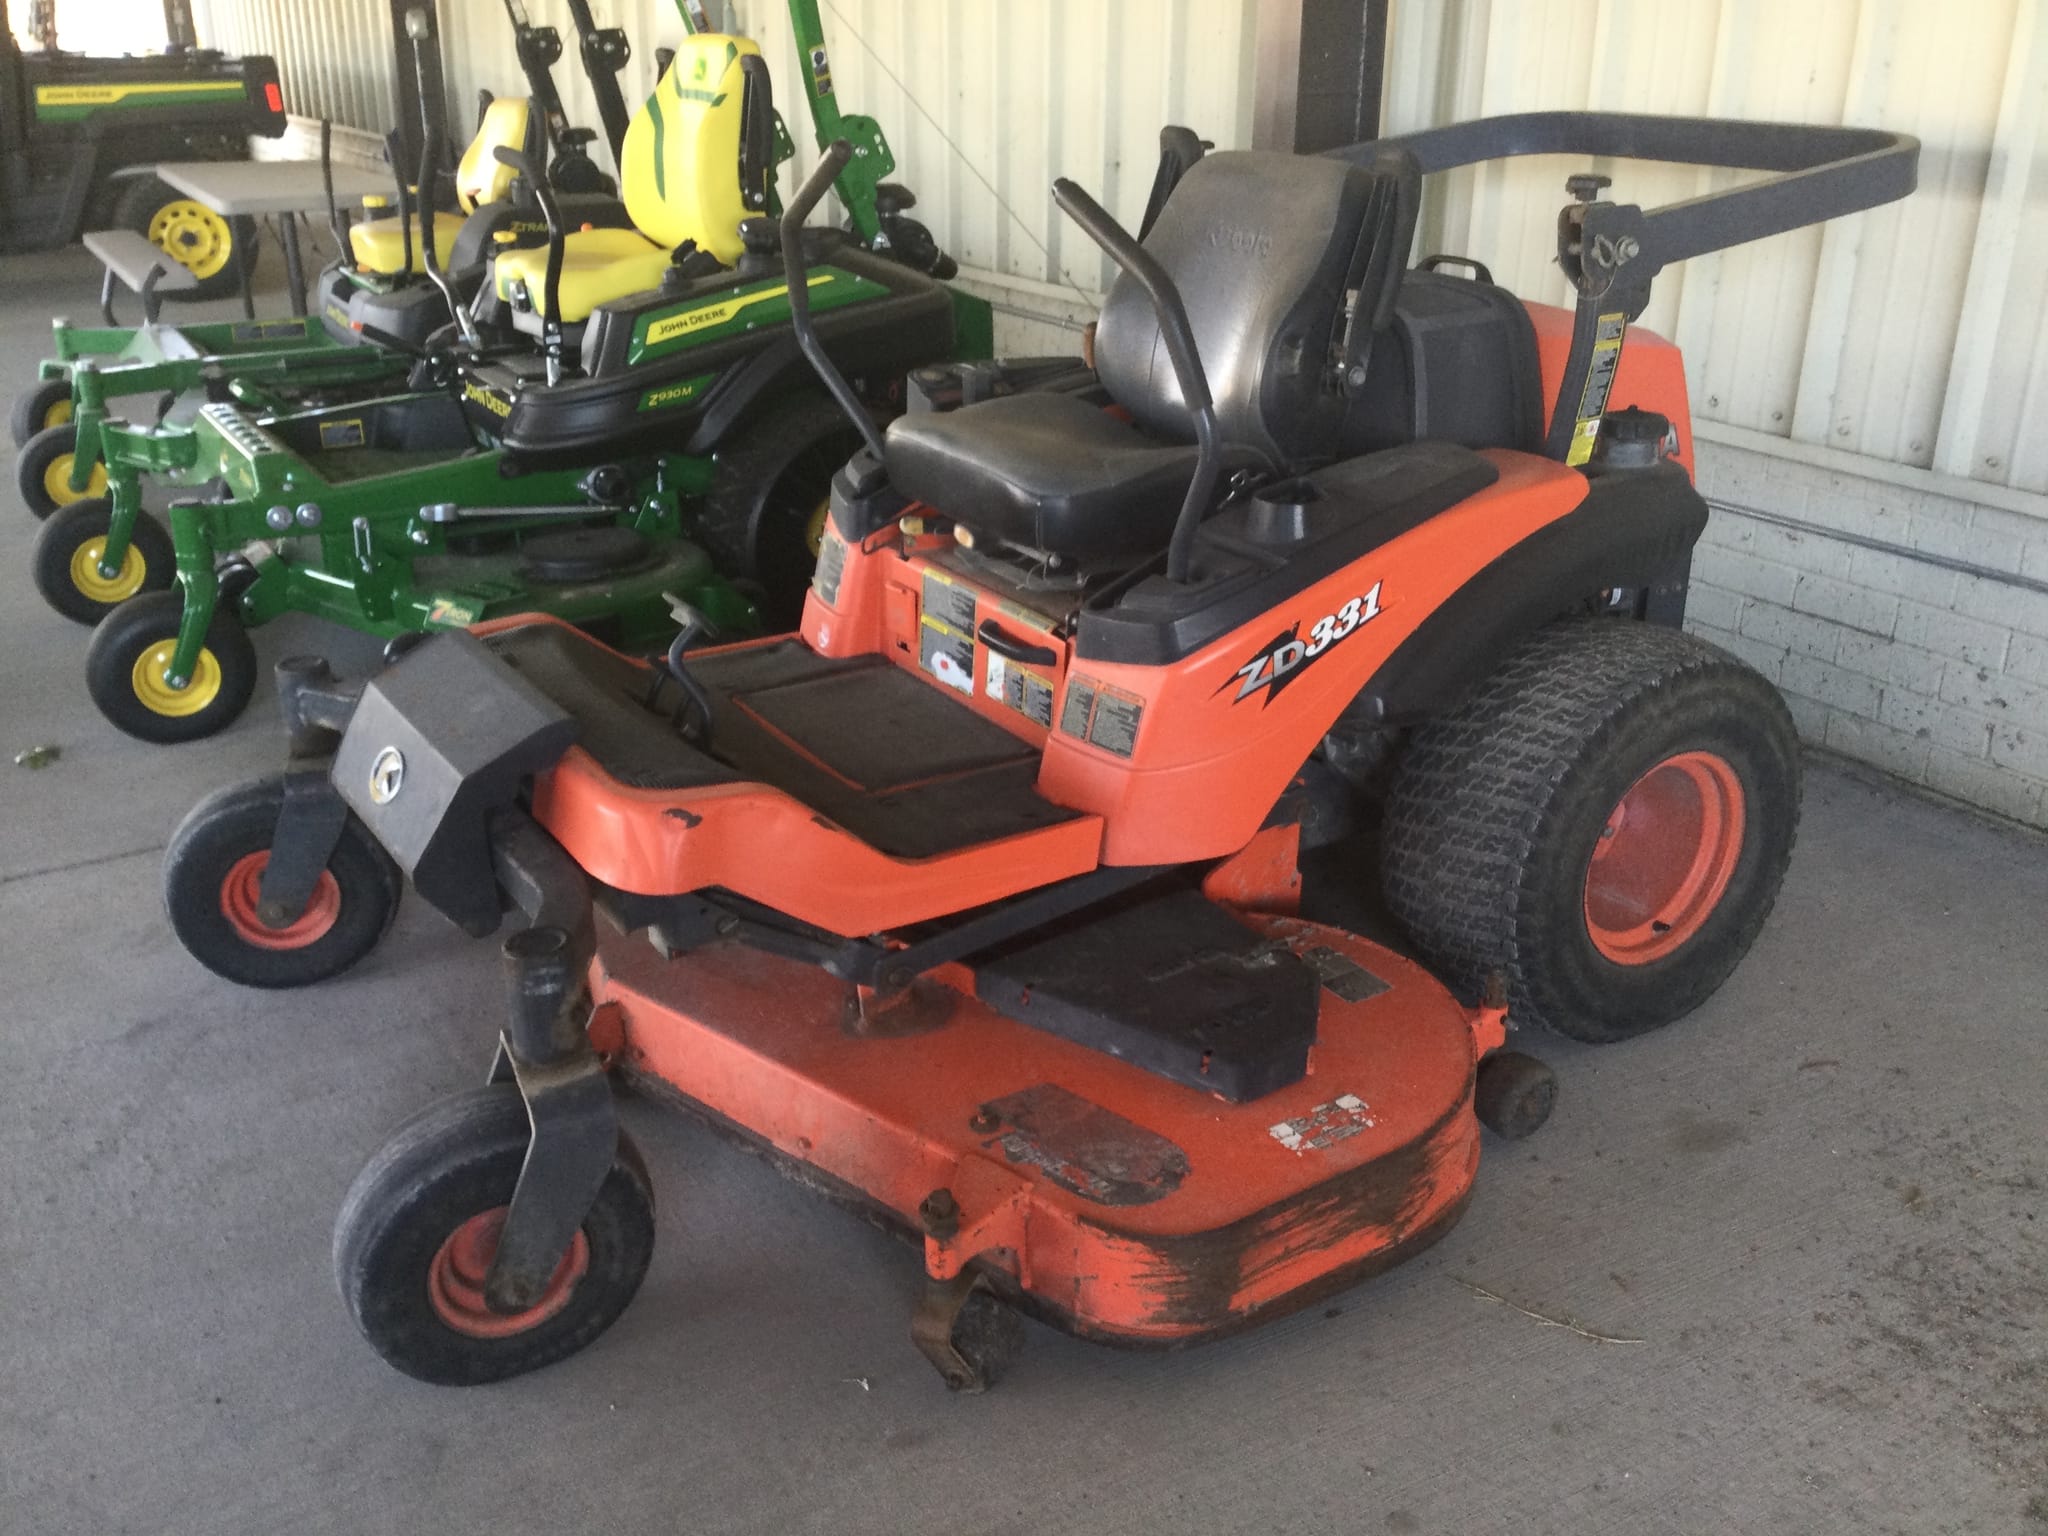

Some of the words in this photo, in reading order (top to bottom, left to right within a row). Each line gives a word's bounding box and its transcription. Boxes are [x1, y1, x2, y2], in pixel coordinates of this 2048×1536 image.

[659, 320, 689, 336] JOHN
[689, 308, 727, 326] DEERE
[648, 386, 693, 407] Z930M
[1236, 580, 1383, 702] ZD331
